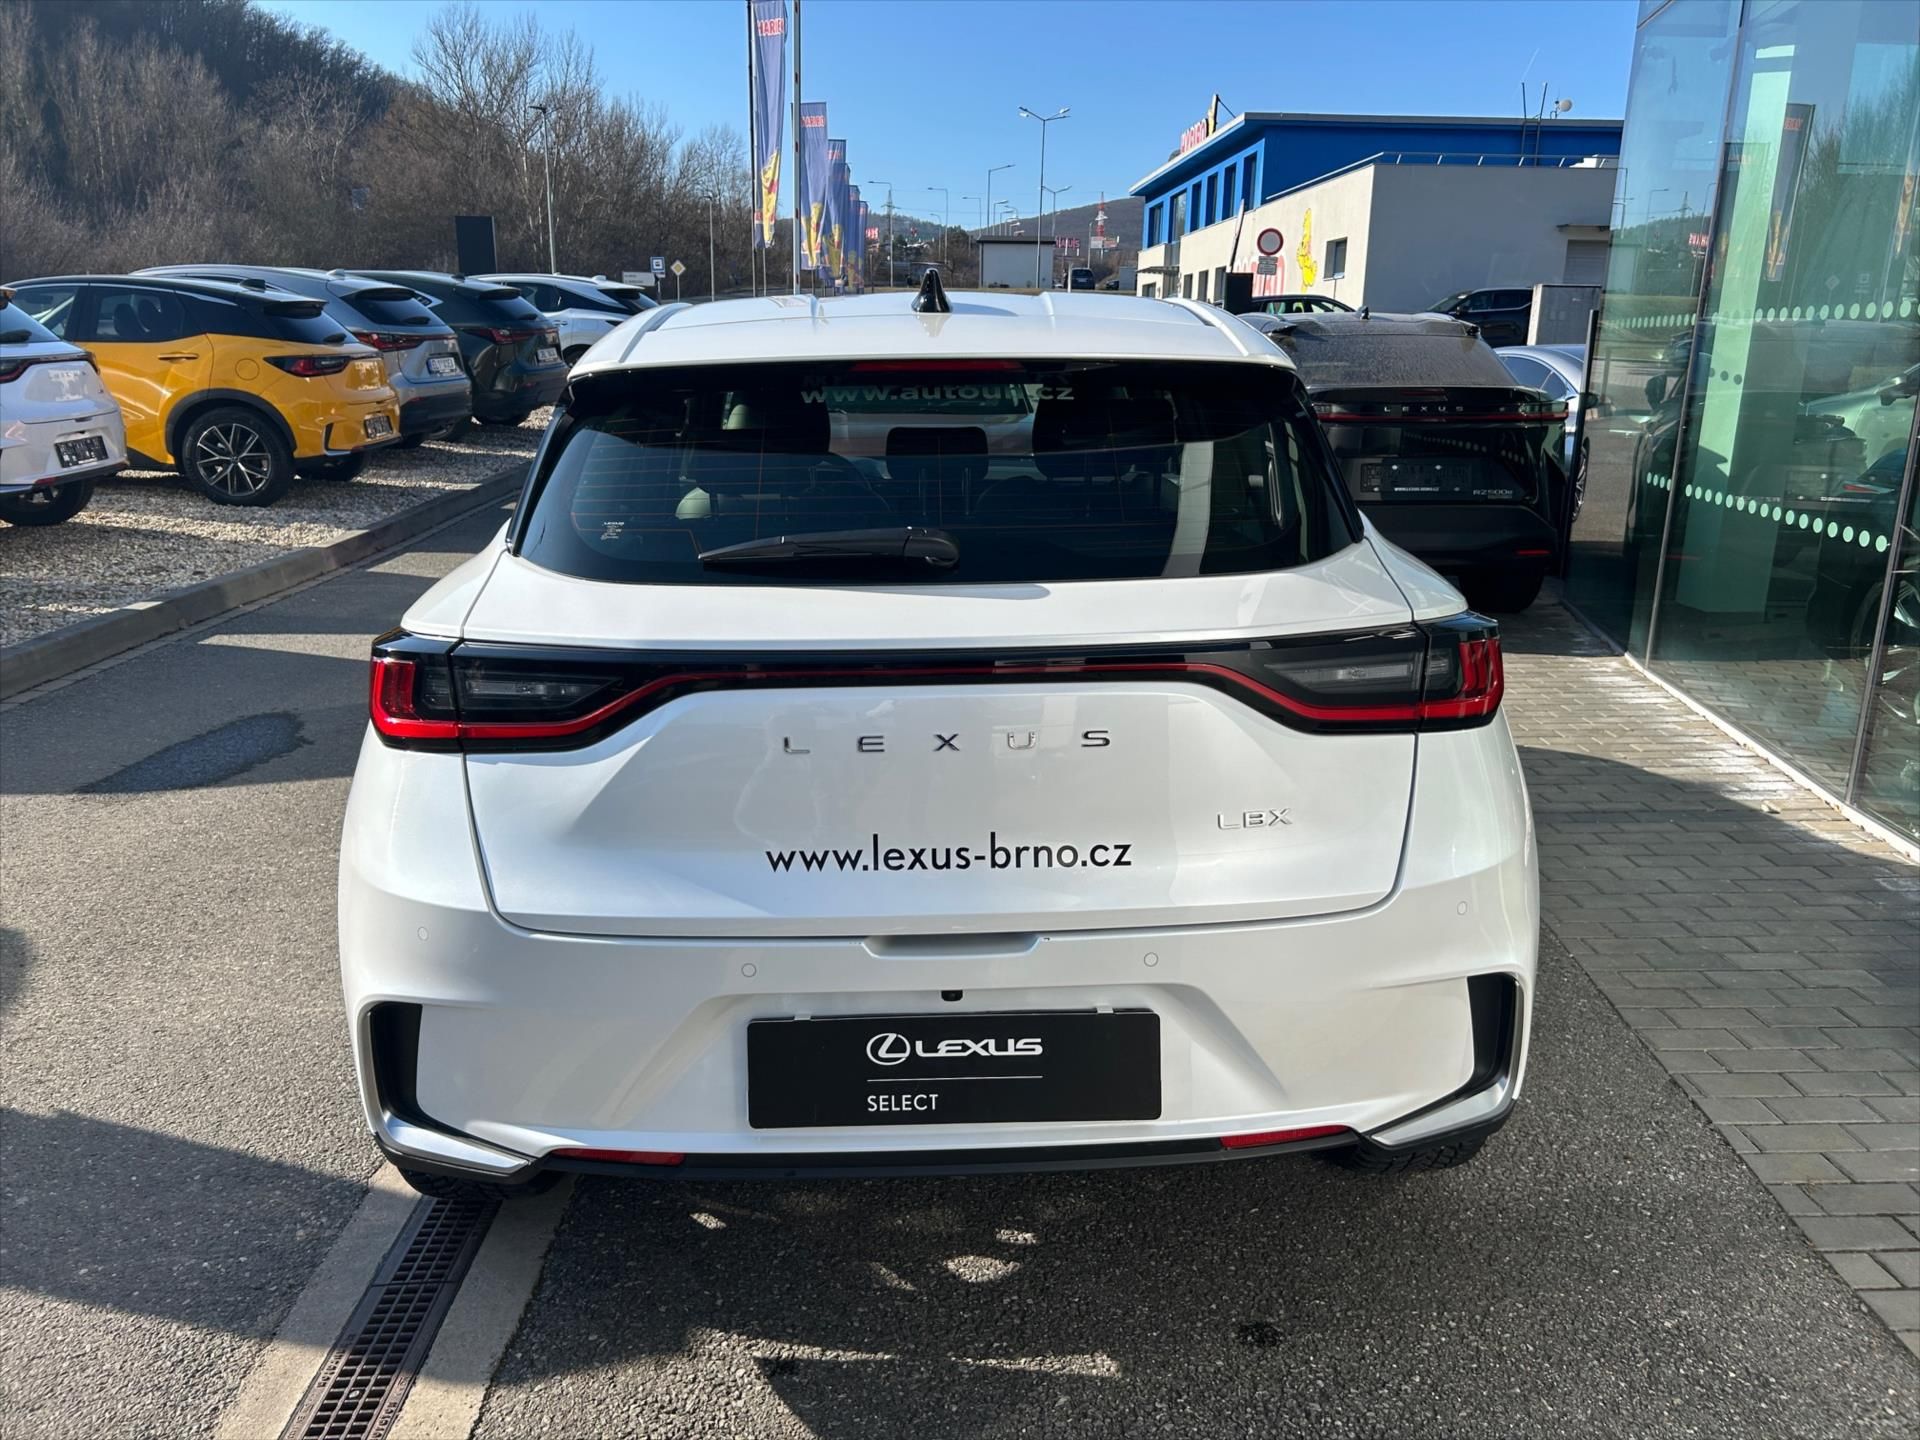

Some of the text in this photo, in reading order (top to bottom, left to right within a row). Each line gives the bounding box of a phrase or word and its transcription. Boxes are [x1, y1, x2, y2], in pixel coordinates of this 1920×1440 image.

[783, 730, 1111, 755] LEXUS
[1217, 807, 1293, 830] LBX
[765, 831, 1132, 872] www.lexus-brno.cz
[915, 1038, 1043, 1057] LEXUS
[867, 1094, 939, 1112] SELECT
